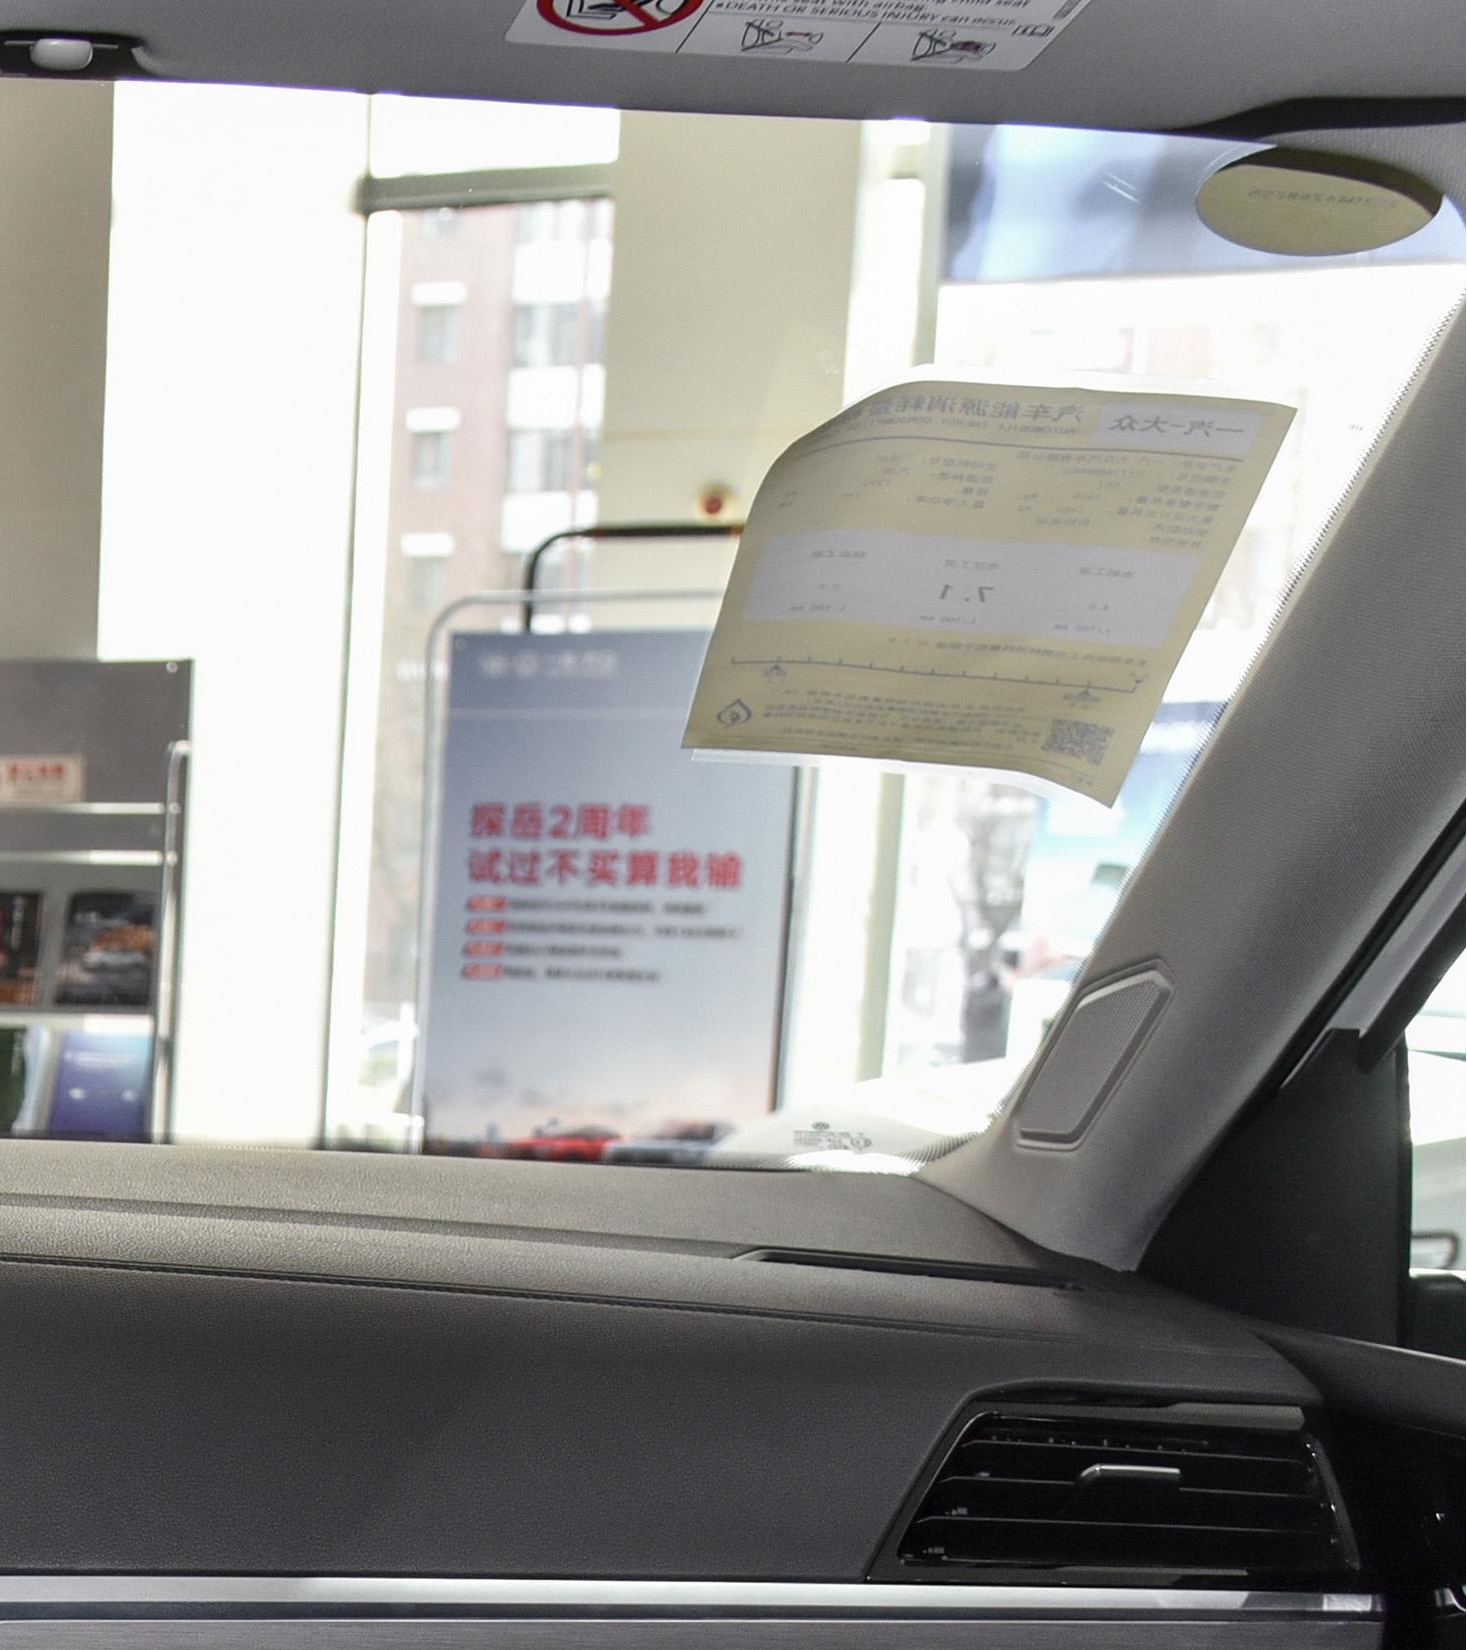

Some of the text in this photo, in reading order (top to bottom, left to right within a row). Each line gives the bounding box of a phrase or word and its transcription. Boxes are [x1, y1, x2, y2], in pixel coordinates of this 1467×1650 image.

[724, 1, 780, 11] DEATH
[783, 5, 805, 13] OR
[811, 7, 879, 17] SERIOUS
[880, 10, 942, 21] INJURY
[470, 801, 651, 841] 探岳2周年
[467, 849, 743, 891] 试过不买算我输
